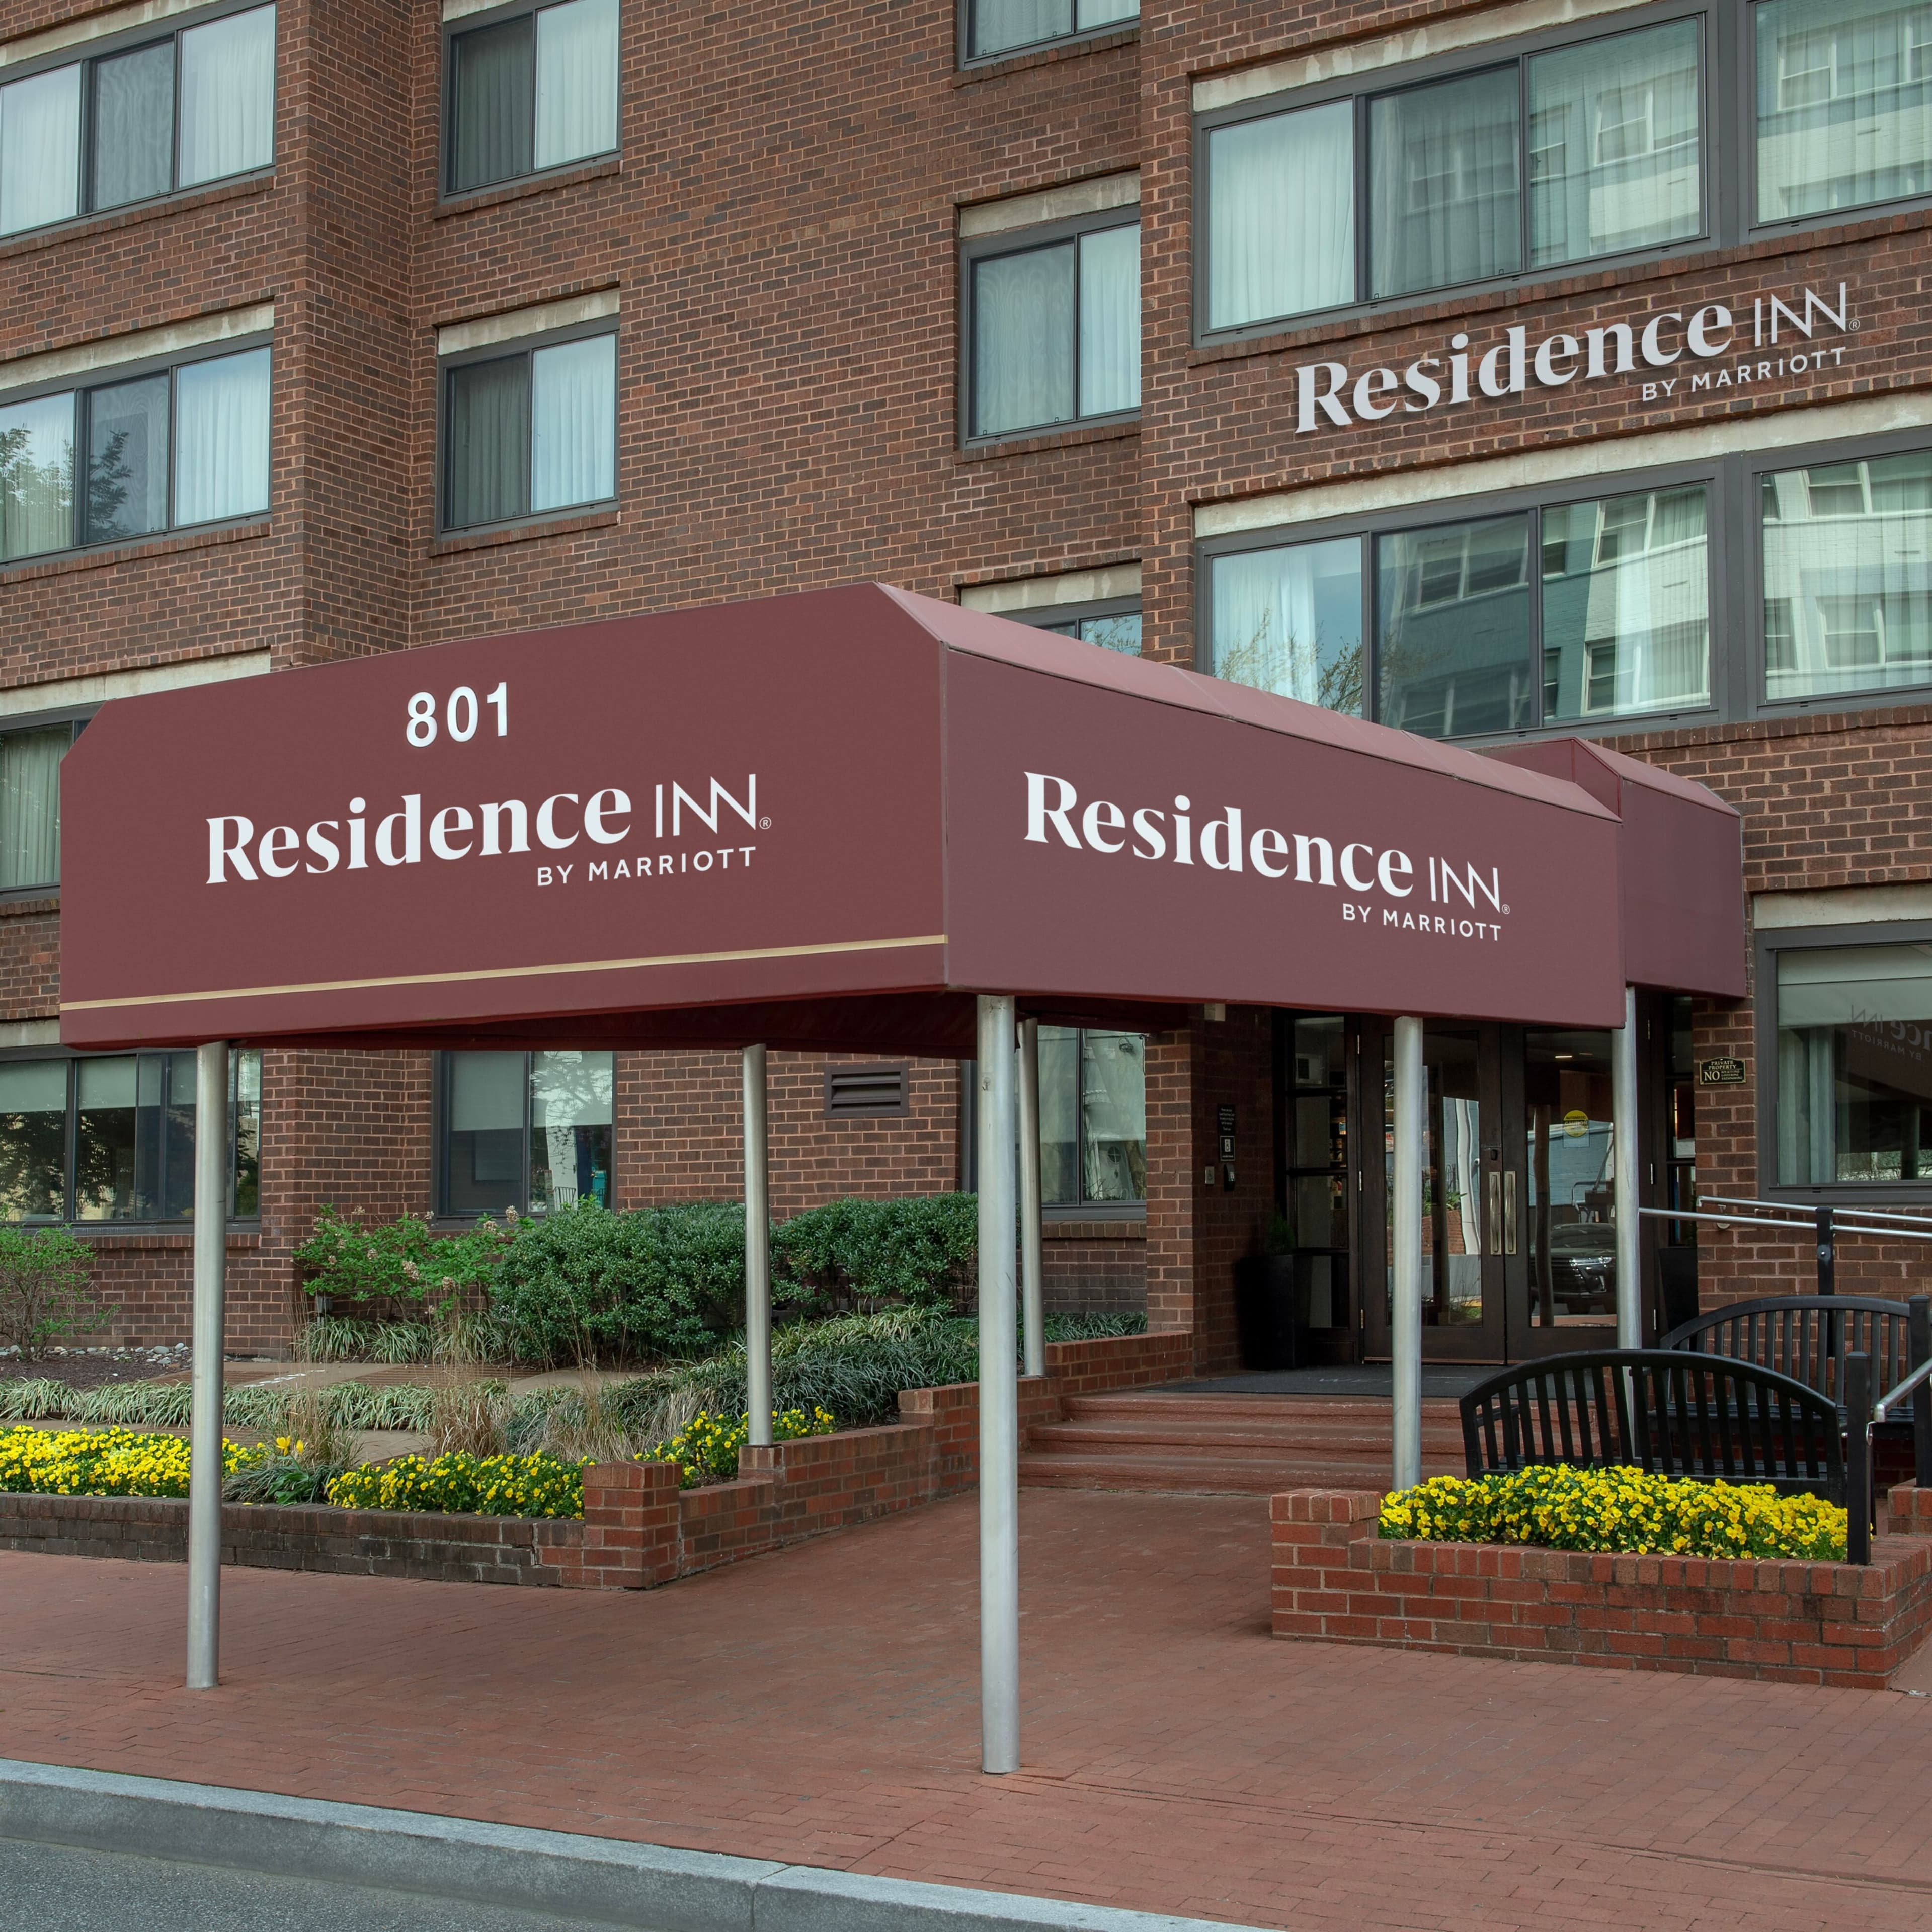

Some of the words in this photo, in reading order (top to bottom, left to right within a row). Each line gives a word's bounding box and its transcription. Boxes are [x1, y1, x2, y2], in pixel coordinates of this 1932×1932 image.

[1295, 304, 1733, 433] Residence
[1642, 378, 1677, 402] BY
[1692, 346, 1847, 392] MARRIOTT
[406, 682, 508, 748] 801
[206, 788, 632, 884] Residence
[1023, 771, 1414, 898] Residence
[537, 864, 574, 887] BY
[589, 846, 756, 881] MARRIOTT
[1343, 903, 1372, 923] BY
[1383, 909, 1502, 941] MARRIOTT
[1704, 1071, 1720, 1081] NO
